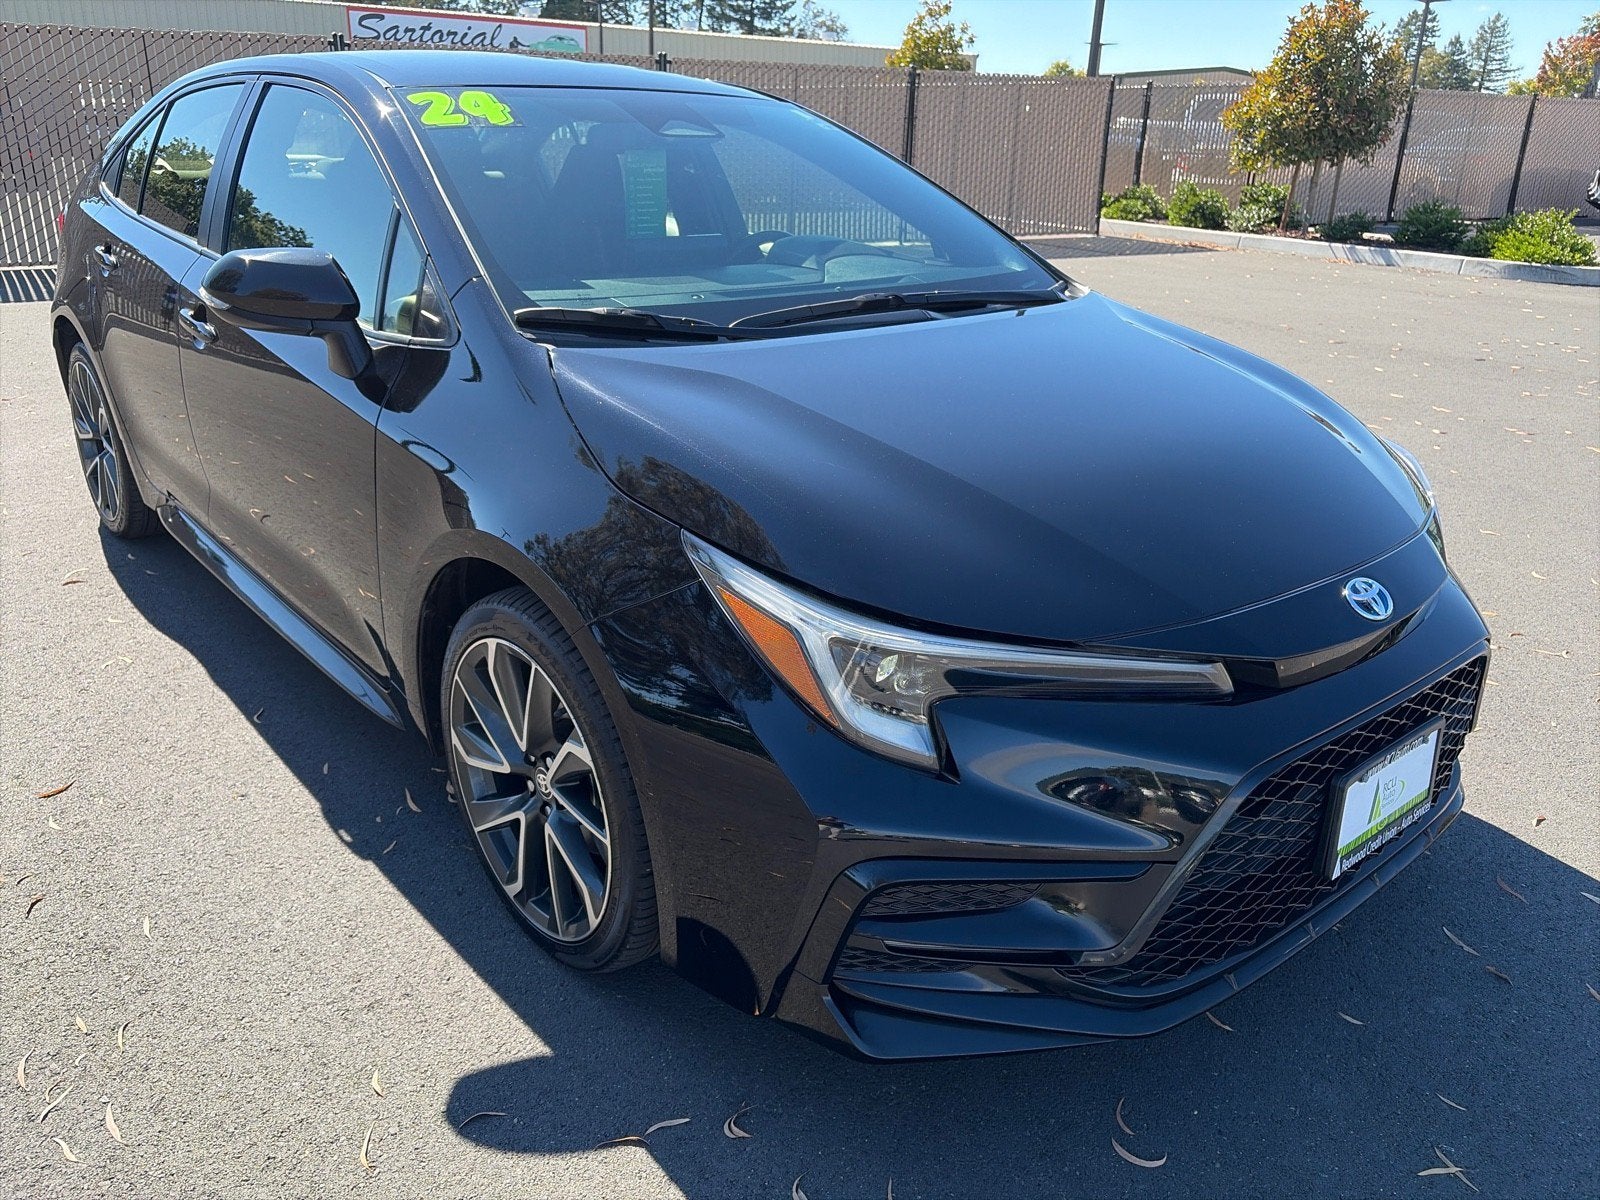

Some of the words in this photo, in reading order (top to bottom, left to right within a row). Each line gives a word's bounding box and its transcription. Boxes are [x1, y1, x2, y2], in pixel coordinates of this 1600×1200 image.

[353, 13, 503, 49] Sartorial
[406, 90, 515, 126] 24
[1383, 776, 1397, 794] RCU
[1341, 843, 1367, 871] Redwood
[1366, 834, 1382, 856] Credit
[1382, 825, 1398, 844] Union
[1401, 814, 1413, 832] Auto
[1413, 801, 1431, 822] Services
